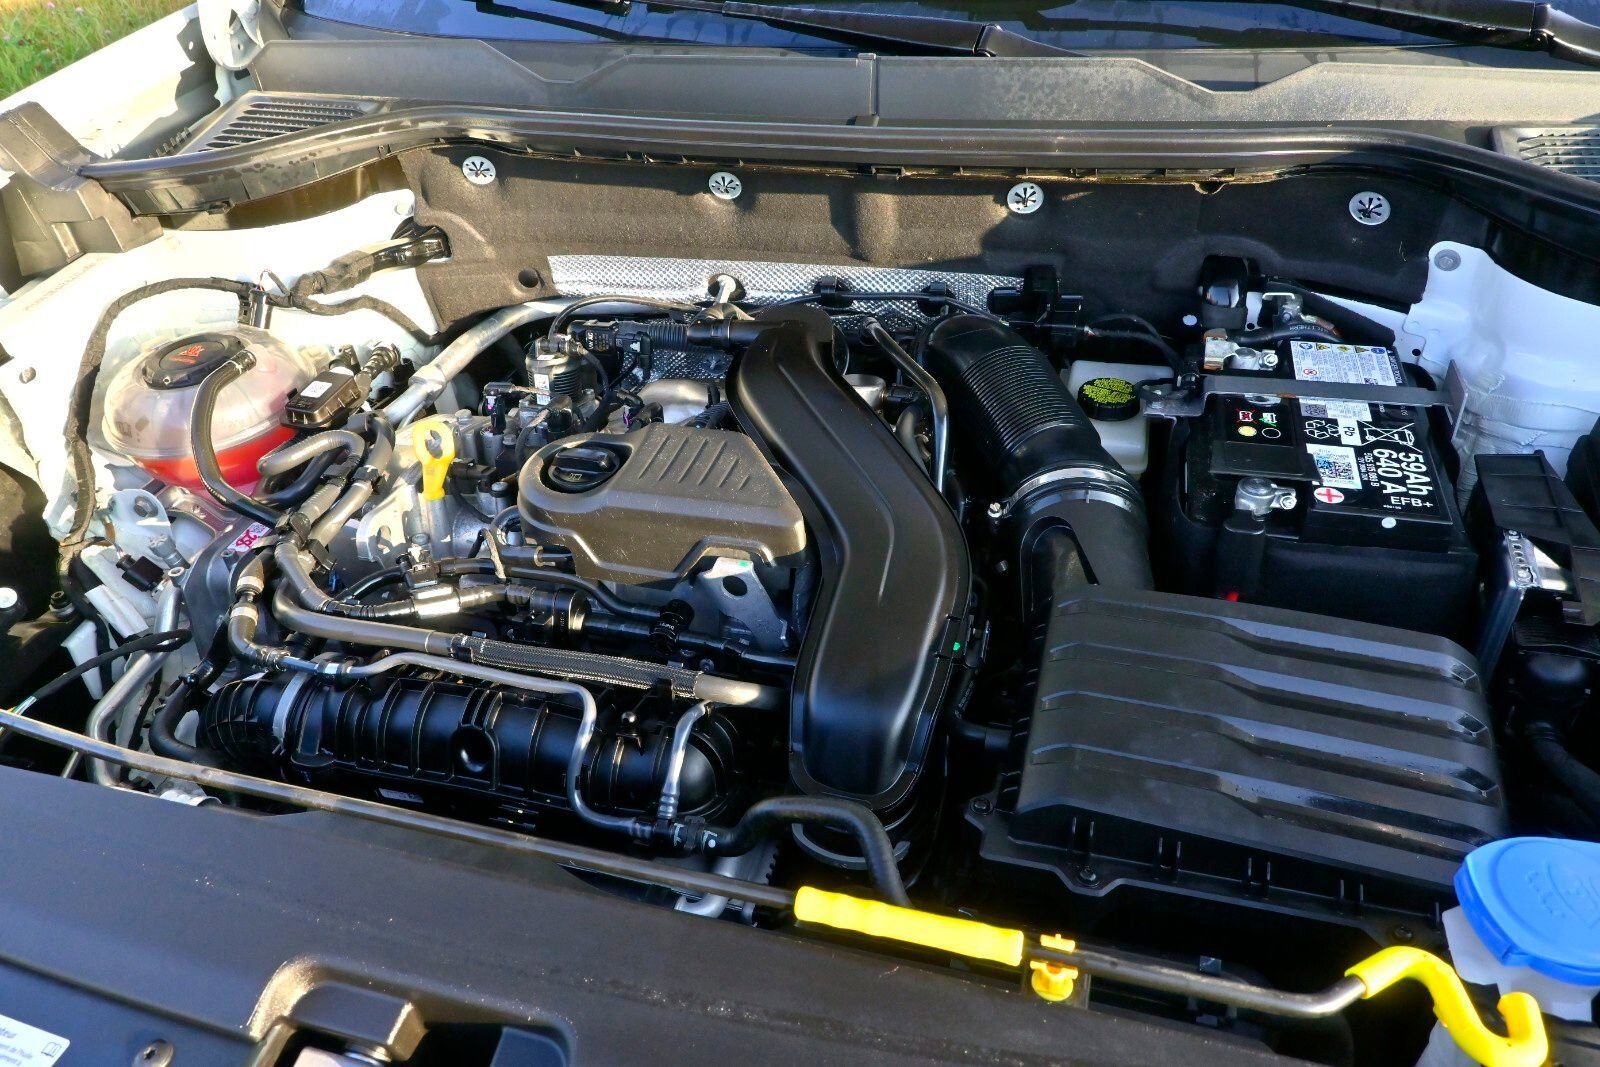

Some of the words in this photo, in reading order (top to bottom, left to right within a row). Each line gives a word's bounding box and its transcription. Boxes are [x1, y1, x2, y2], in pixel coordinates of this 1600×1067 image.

[1343, 426, 1355, 437] Pb
[1373, 448, 1403, 478] 640
[1399, 451, 1433, 496] 59Ah
[1380, 480, 1407, 494] A
[1390, 496, 1433, 508] EFB+
